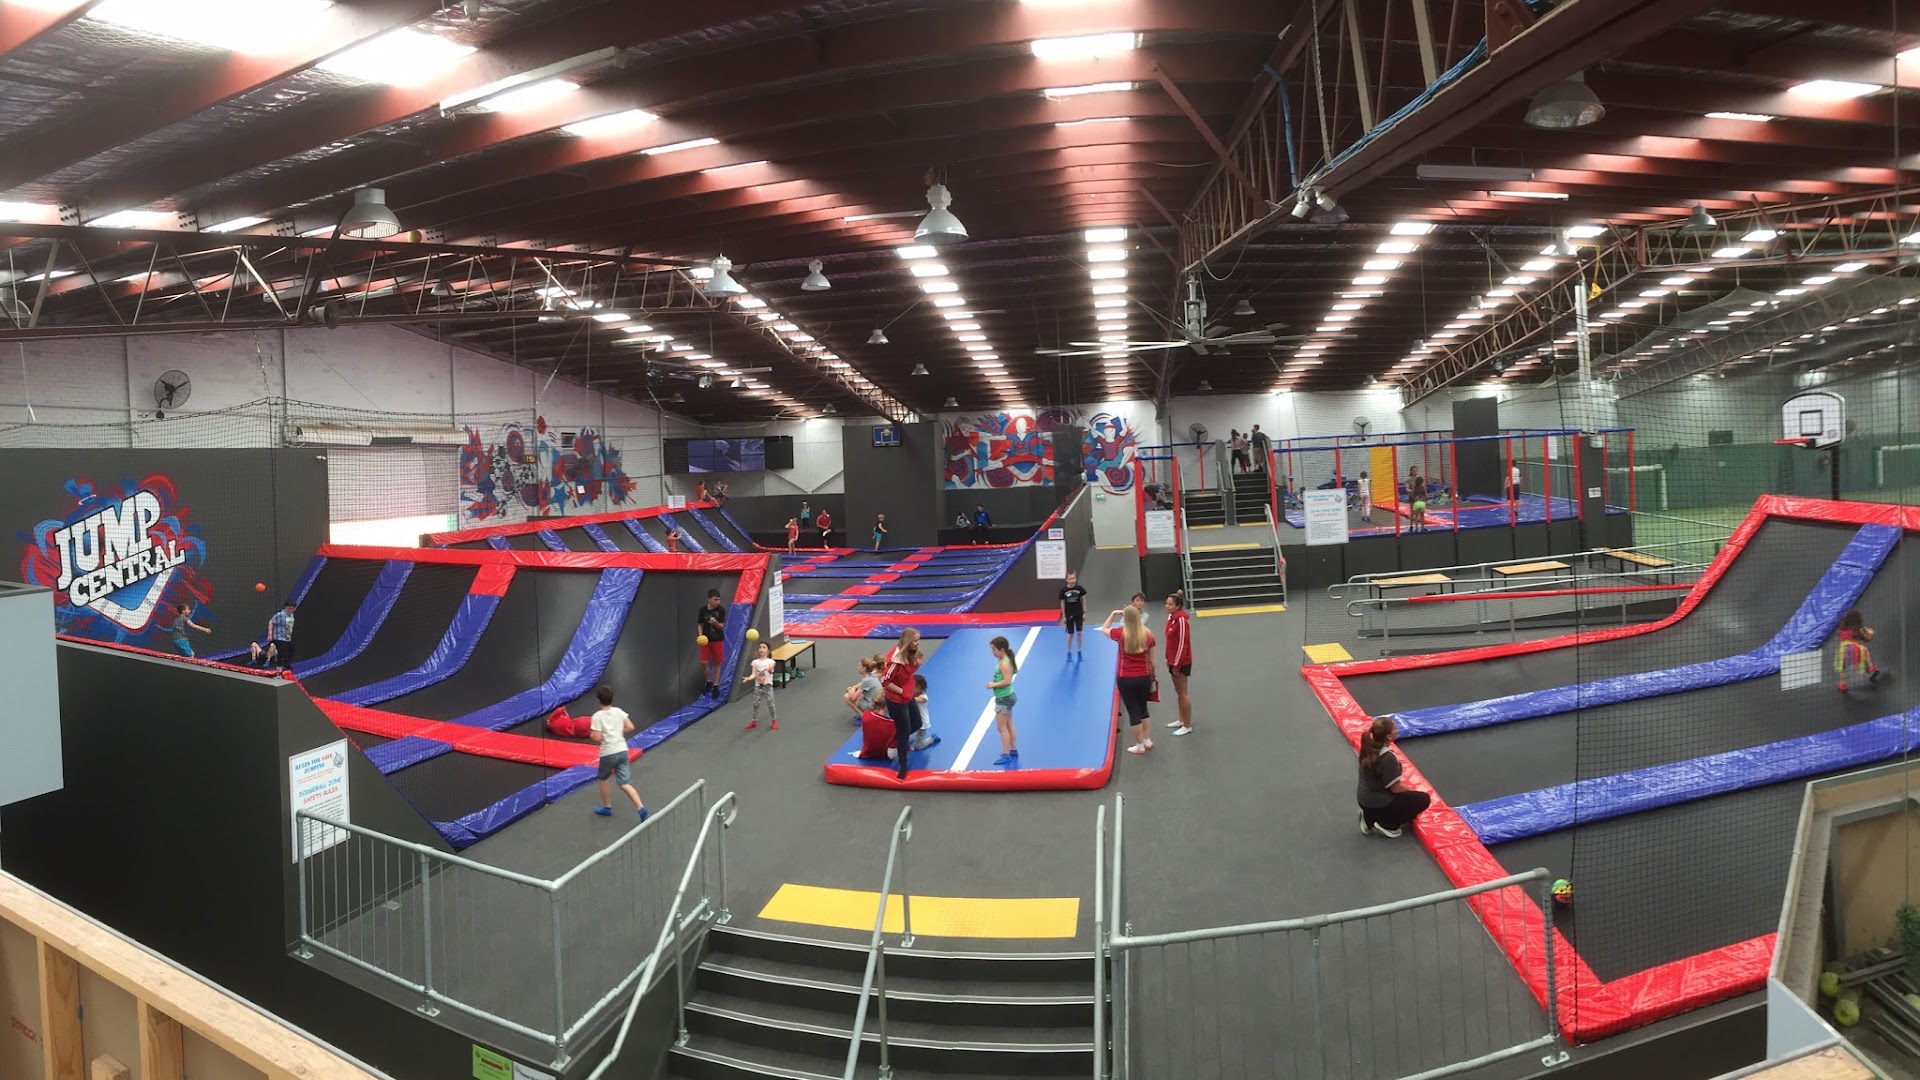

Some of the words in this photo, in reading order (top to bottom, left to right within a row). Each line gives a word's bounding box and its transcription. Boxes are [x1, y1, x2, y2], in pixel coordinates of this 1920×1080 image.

[54, 489, 161, 591] JUMP
[68, 539, 186, 607] CENTRAL
[298, 783, 327, 798] DODGEBALL
[328, 776, 342, 786] ZONE
[303, 792, 322, 804] SAFETY
[323, 786, 338, 796] RULES
